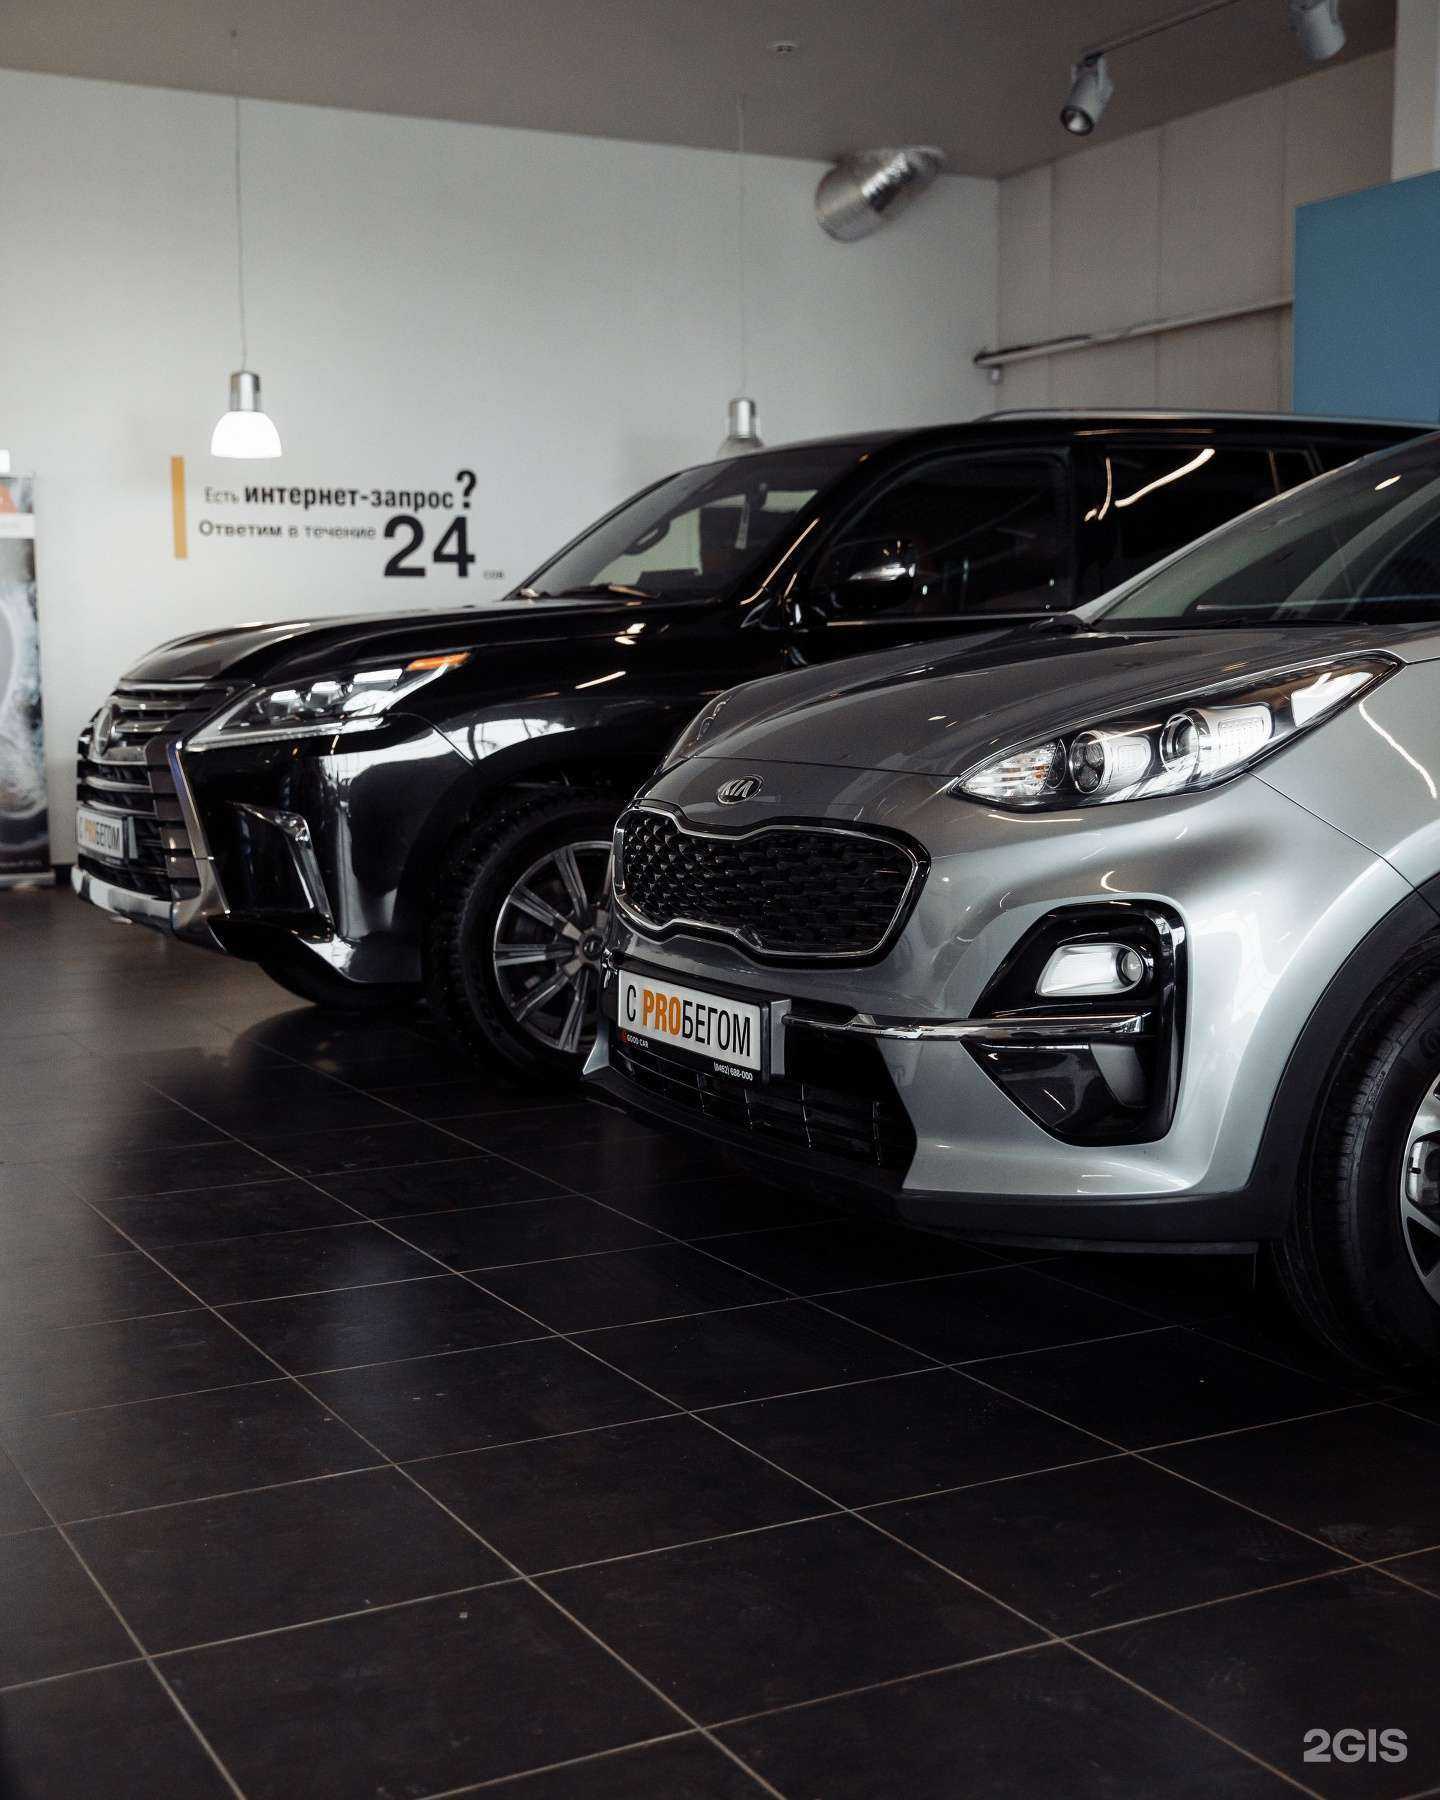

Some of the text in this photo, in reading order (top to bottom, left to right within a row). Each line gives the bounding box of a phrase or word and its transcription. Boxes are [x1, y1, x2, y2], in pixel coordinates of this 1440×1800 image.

[204, 486, 240, 504] Есть
[199, 519, 282, 537] Ответим
[383, 514, 476, 577] 24
[719, 778, 754, 798] KIA
[626, 984, 637, 1022] С
